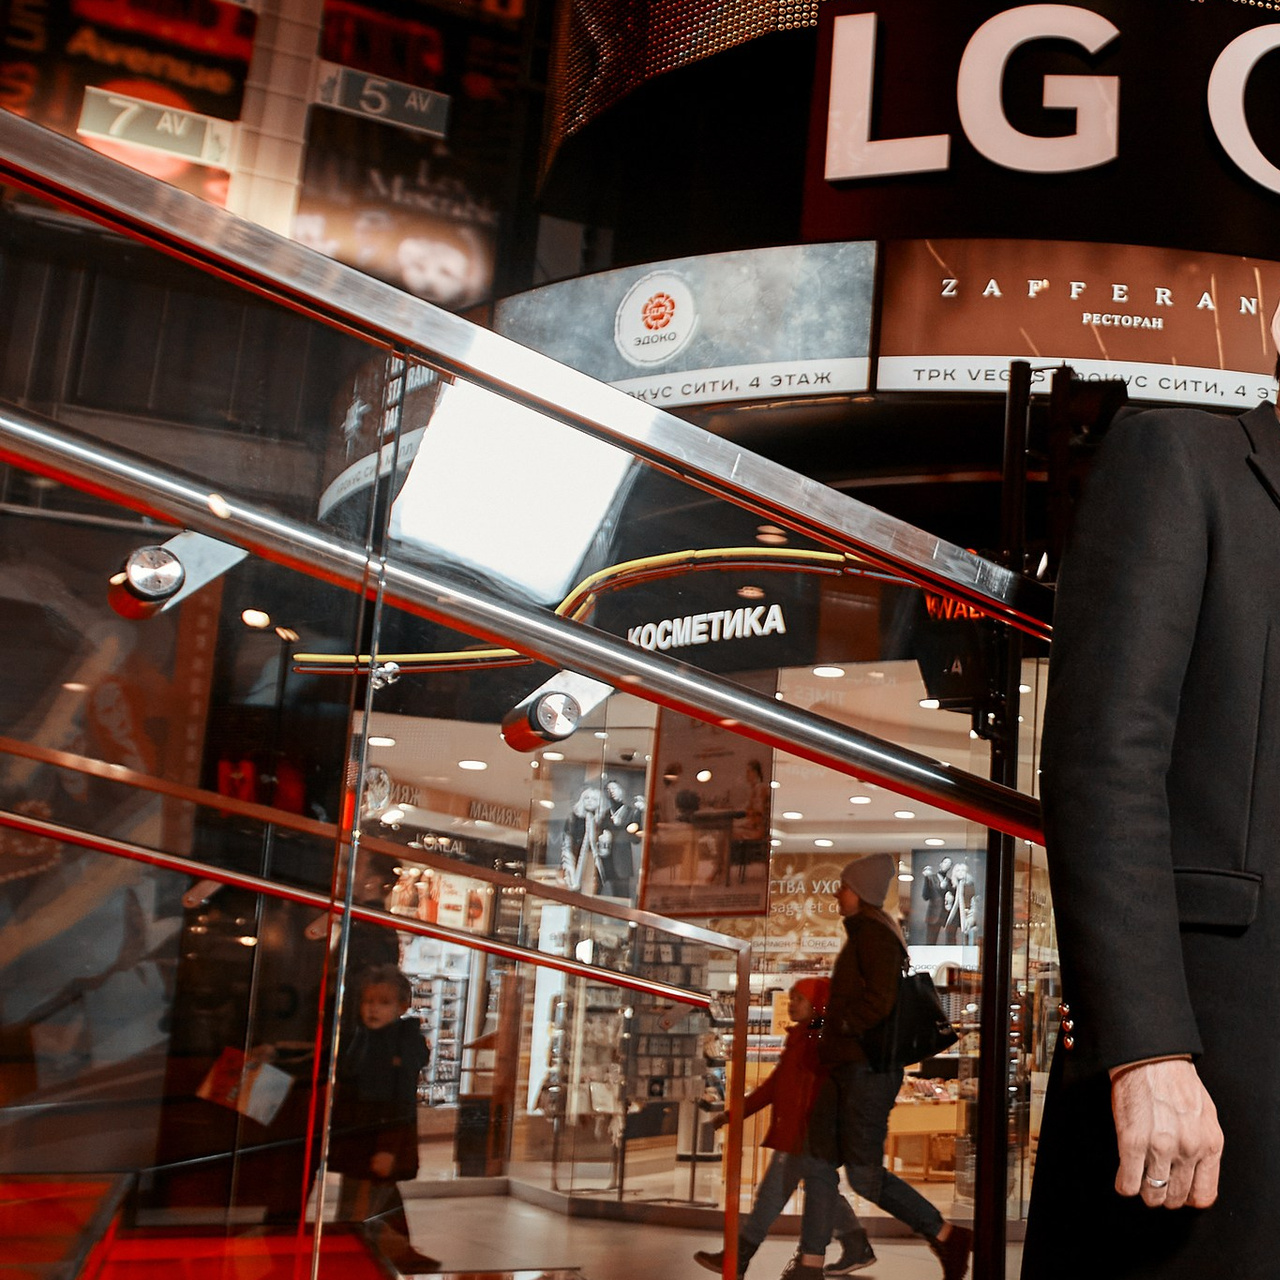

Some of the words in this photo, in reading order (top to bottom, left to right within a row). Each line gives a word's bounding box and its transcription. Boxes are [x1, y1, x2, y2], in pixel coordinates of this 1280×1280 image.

[359, 77, 388, 116] 5
[404, 90, 432, 113] AV
[824, 2, 1122, 182] LG
[108, 97, 142, 136] 7
[156, 111, 189, 136] AV
[1082, 311, 1164, 331] РЕСТОРАН
[633, 331, 677, 348] ЭДОКО
[681, 378, 740, 396] СИТИ,
[748, 375, 761, 389] 4
[769, 371, 833, 388] ЭТАЖ
[912, 367, 961, 381] ТРК
[967, 368, 1045, 383] VEGS
[1157, 376, 1225, 397] СИТИ,
[1233, 384, 1248, 398] 4
[627, 603, 787, 652] КОСМЕТИКА
